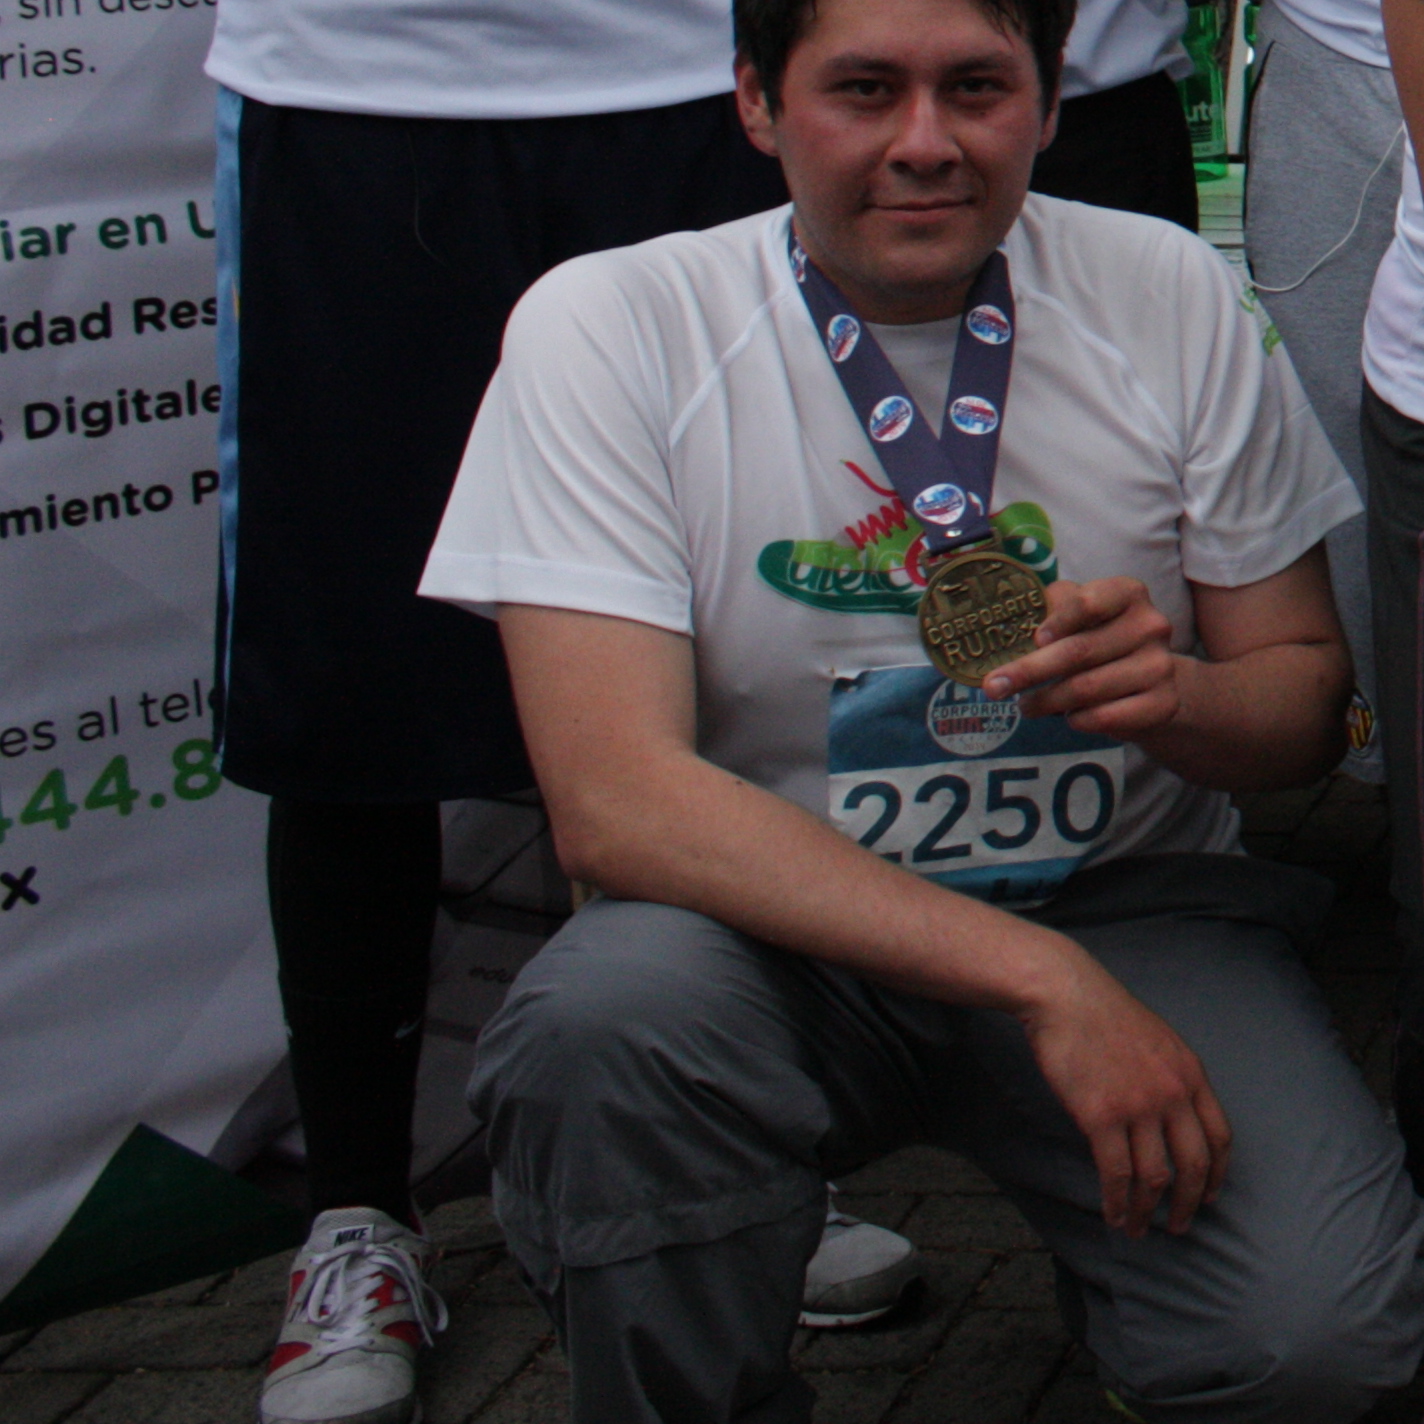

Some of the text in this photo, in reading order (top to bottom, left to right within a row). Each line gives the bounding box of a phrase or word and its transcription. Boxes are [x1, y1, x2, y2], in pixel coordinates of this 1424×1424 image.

[99, 213, 167, 250] en
[25, 379, 221, 440] Digitale
[927, 589, 1044, 645] CORPORATE
[942, 626, 1004, 666] RUN
[77, 695, 119, 741] al
[931, 702, 1018, 720] CORPORATE
[936, 716, 982, 736] RUN
[0, 738, 222, 843] 44.8
[841, 761, 1115, 867] 2250
